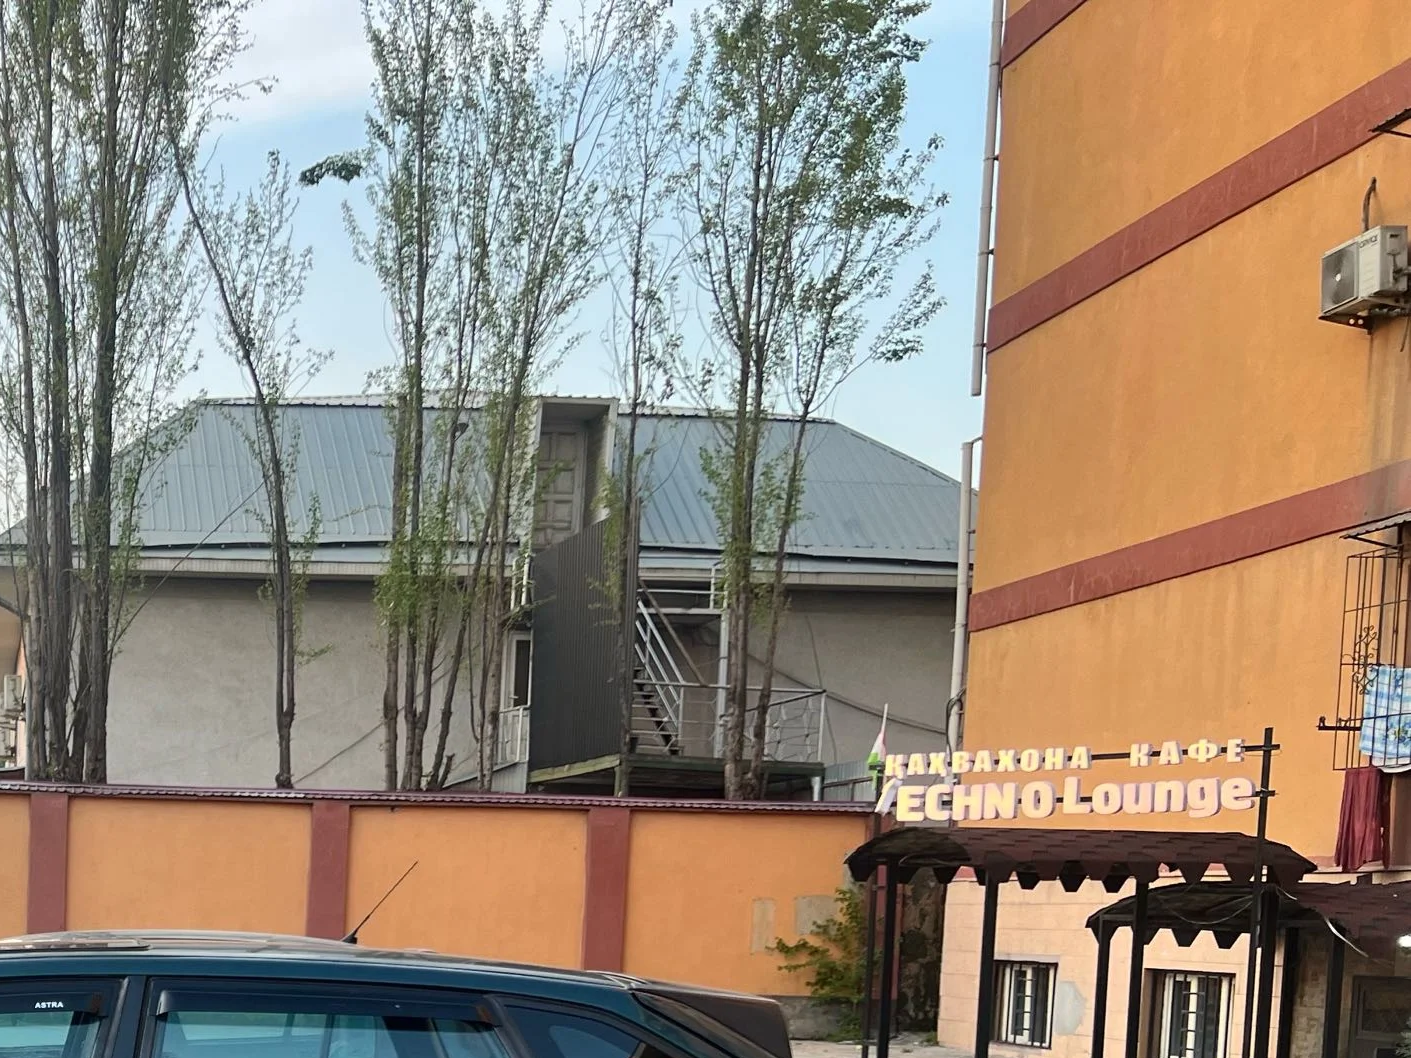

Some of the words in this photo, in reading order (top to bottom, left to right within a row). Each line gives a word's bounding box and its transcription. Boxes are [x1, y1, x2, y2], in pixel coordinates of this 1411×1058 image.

[1129, 738, 1245, 767] КАФЕ
[1062, 776, 1255, 818] Lounge
[34, 1001, 64, 1009] ASTRA
